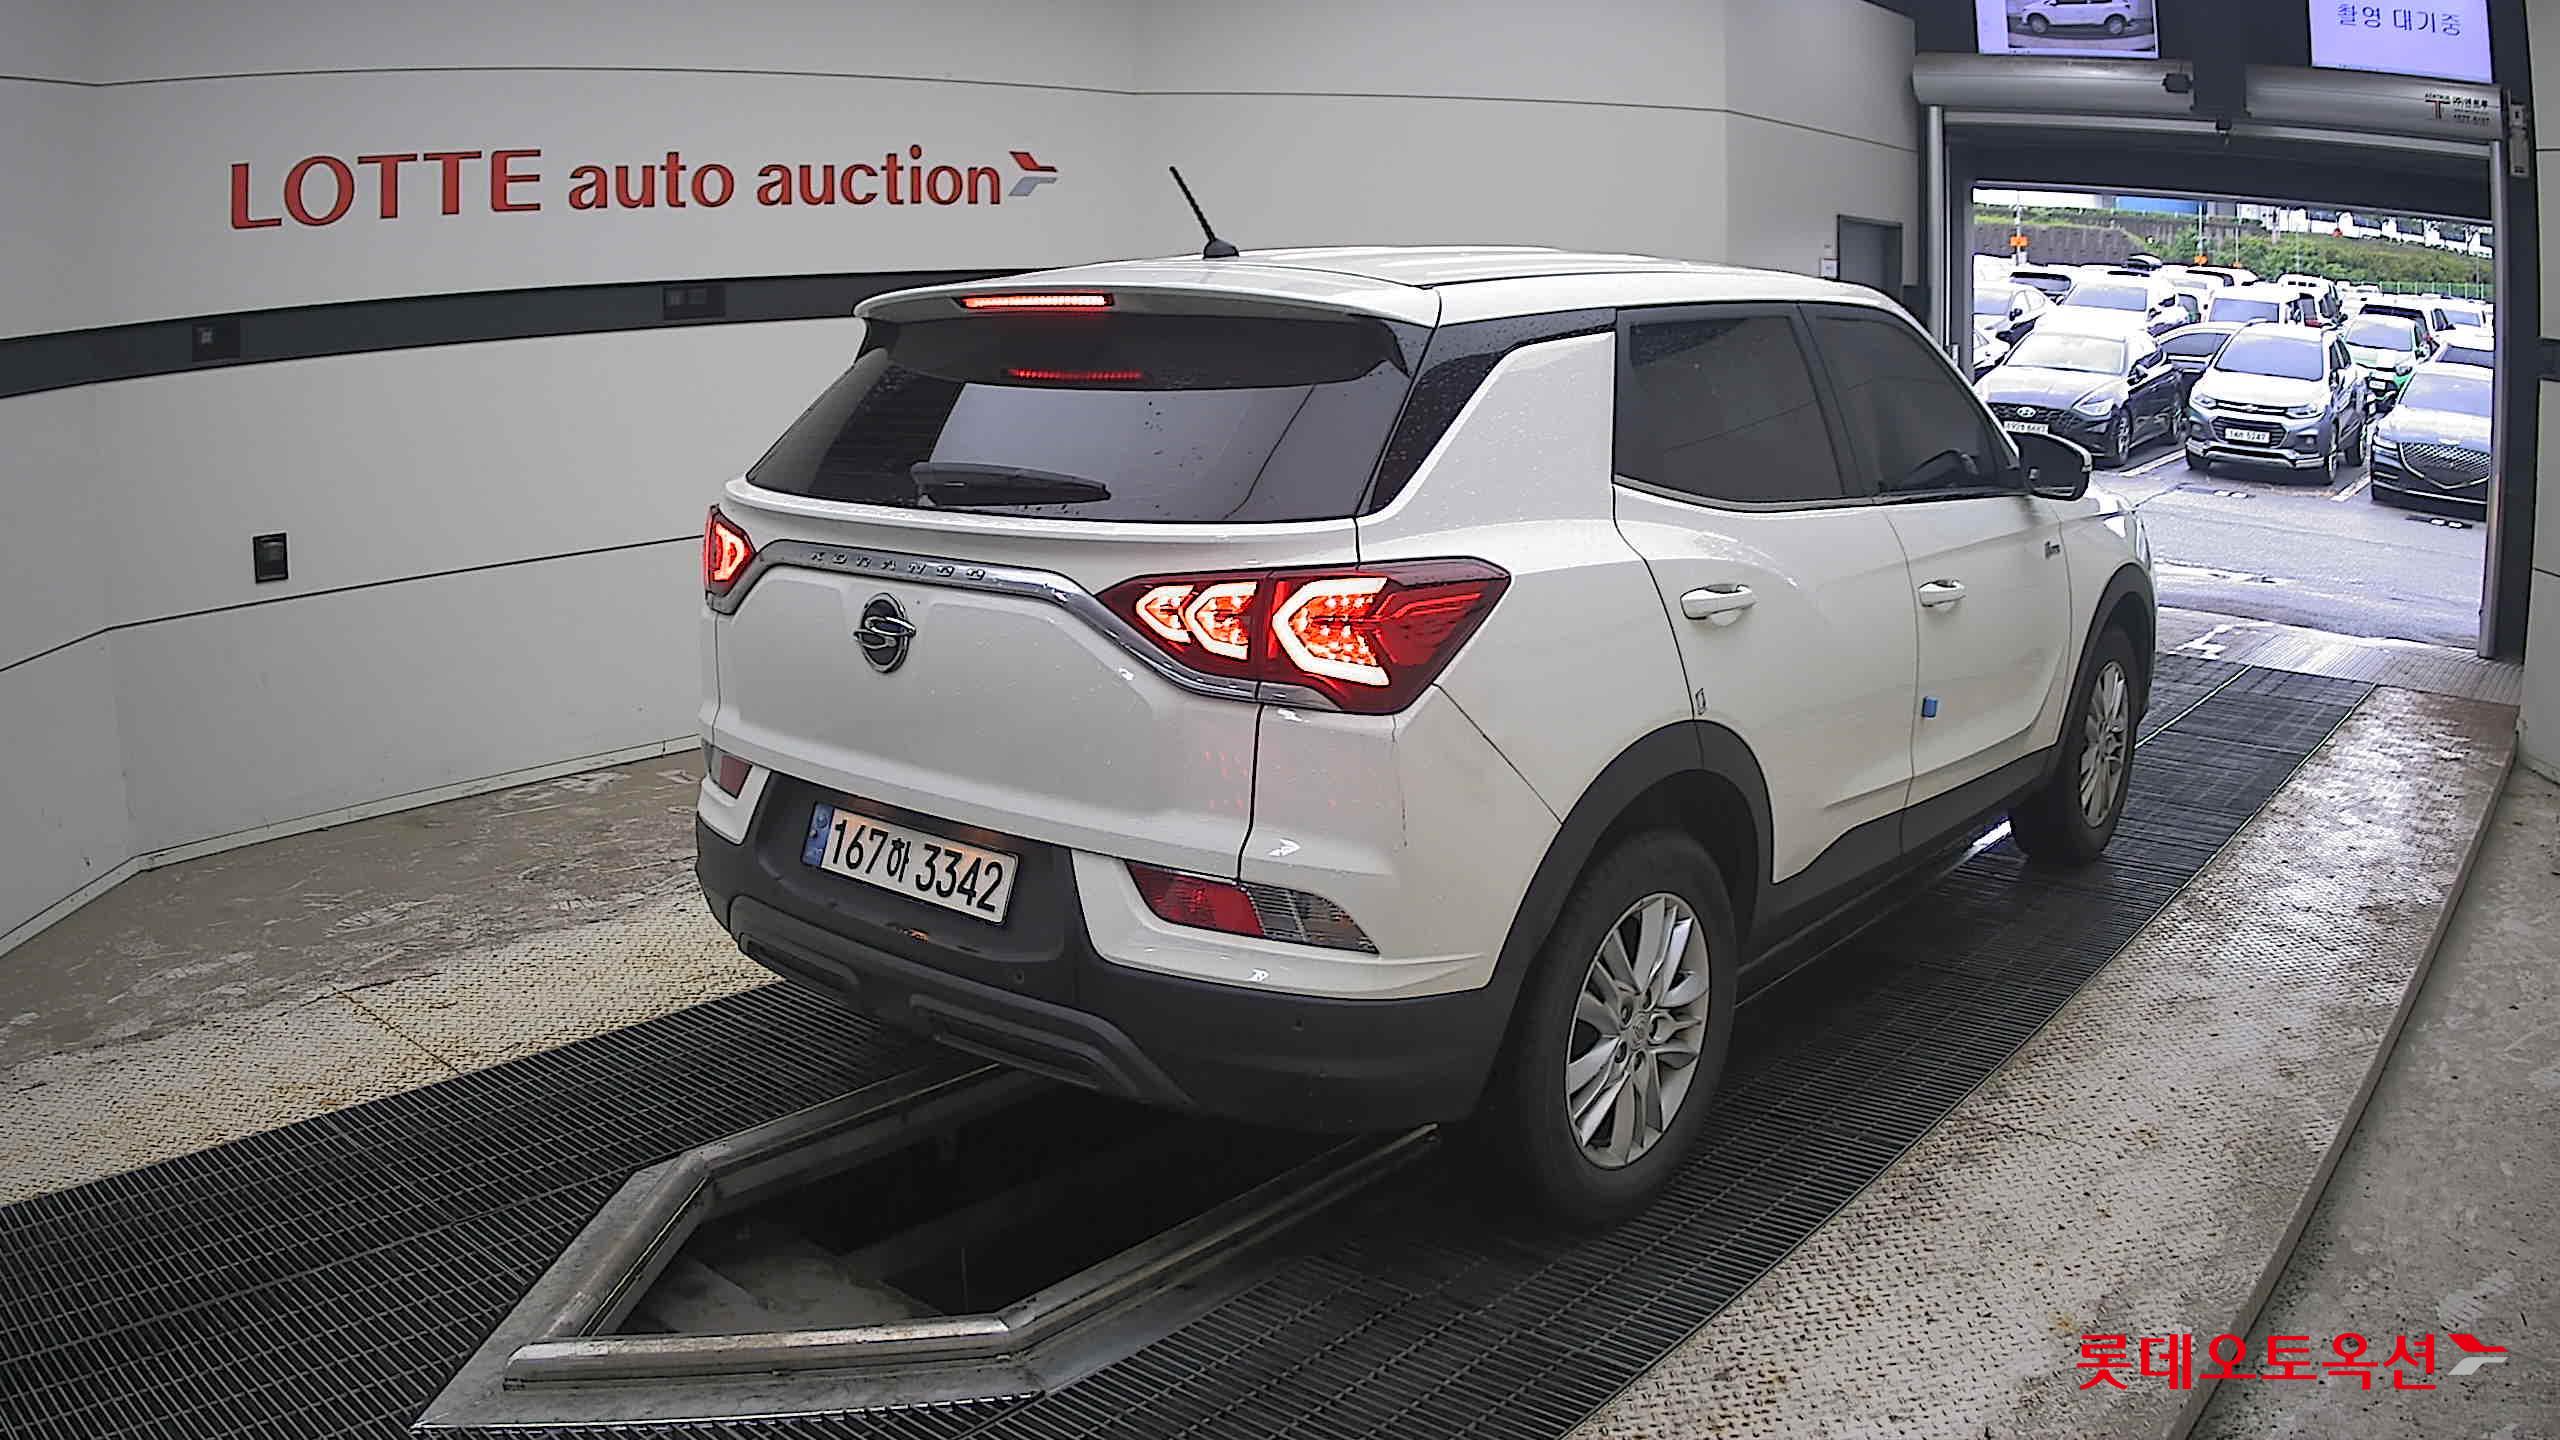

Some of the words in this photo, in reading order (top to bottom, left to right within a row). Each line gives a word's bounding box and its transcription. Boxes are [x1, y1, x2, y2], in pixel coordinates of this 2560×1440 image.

[2337, 3, 2381, 28] 촬영
[2392, 7, 2461, 36] 대기중
[229, 148, 543, 230] LOTTE
[568, 150, 735, 210] auto
[755, 144, 1002, 208] auction
[810, 551, 987, 581] KORANDO
[831, 818, 912, 884] 167하
[915, 842, 1004, 913] 3342
